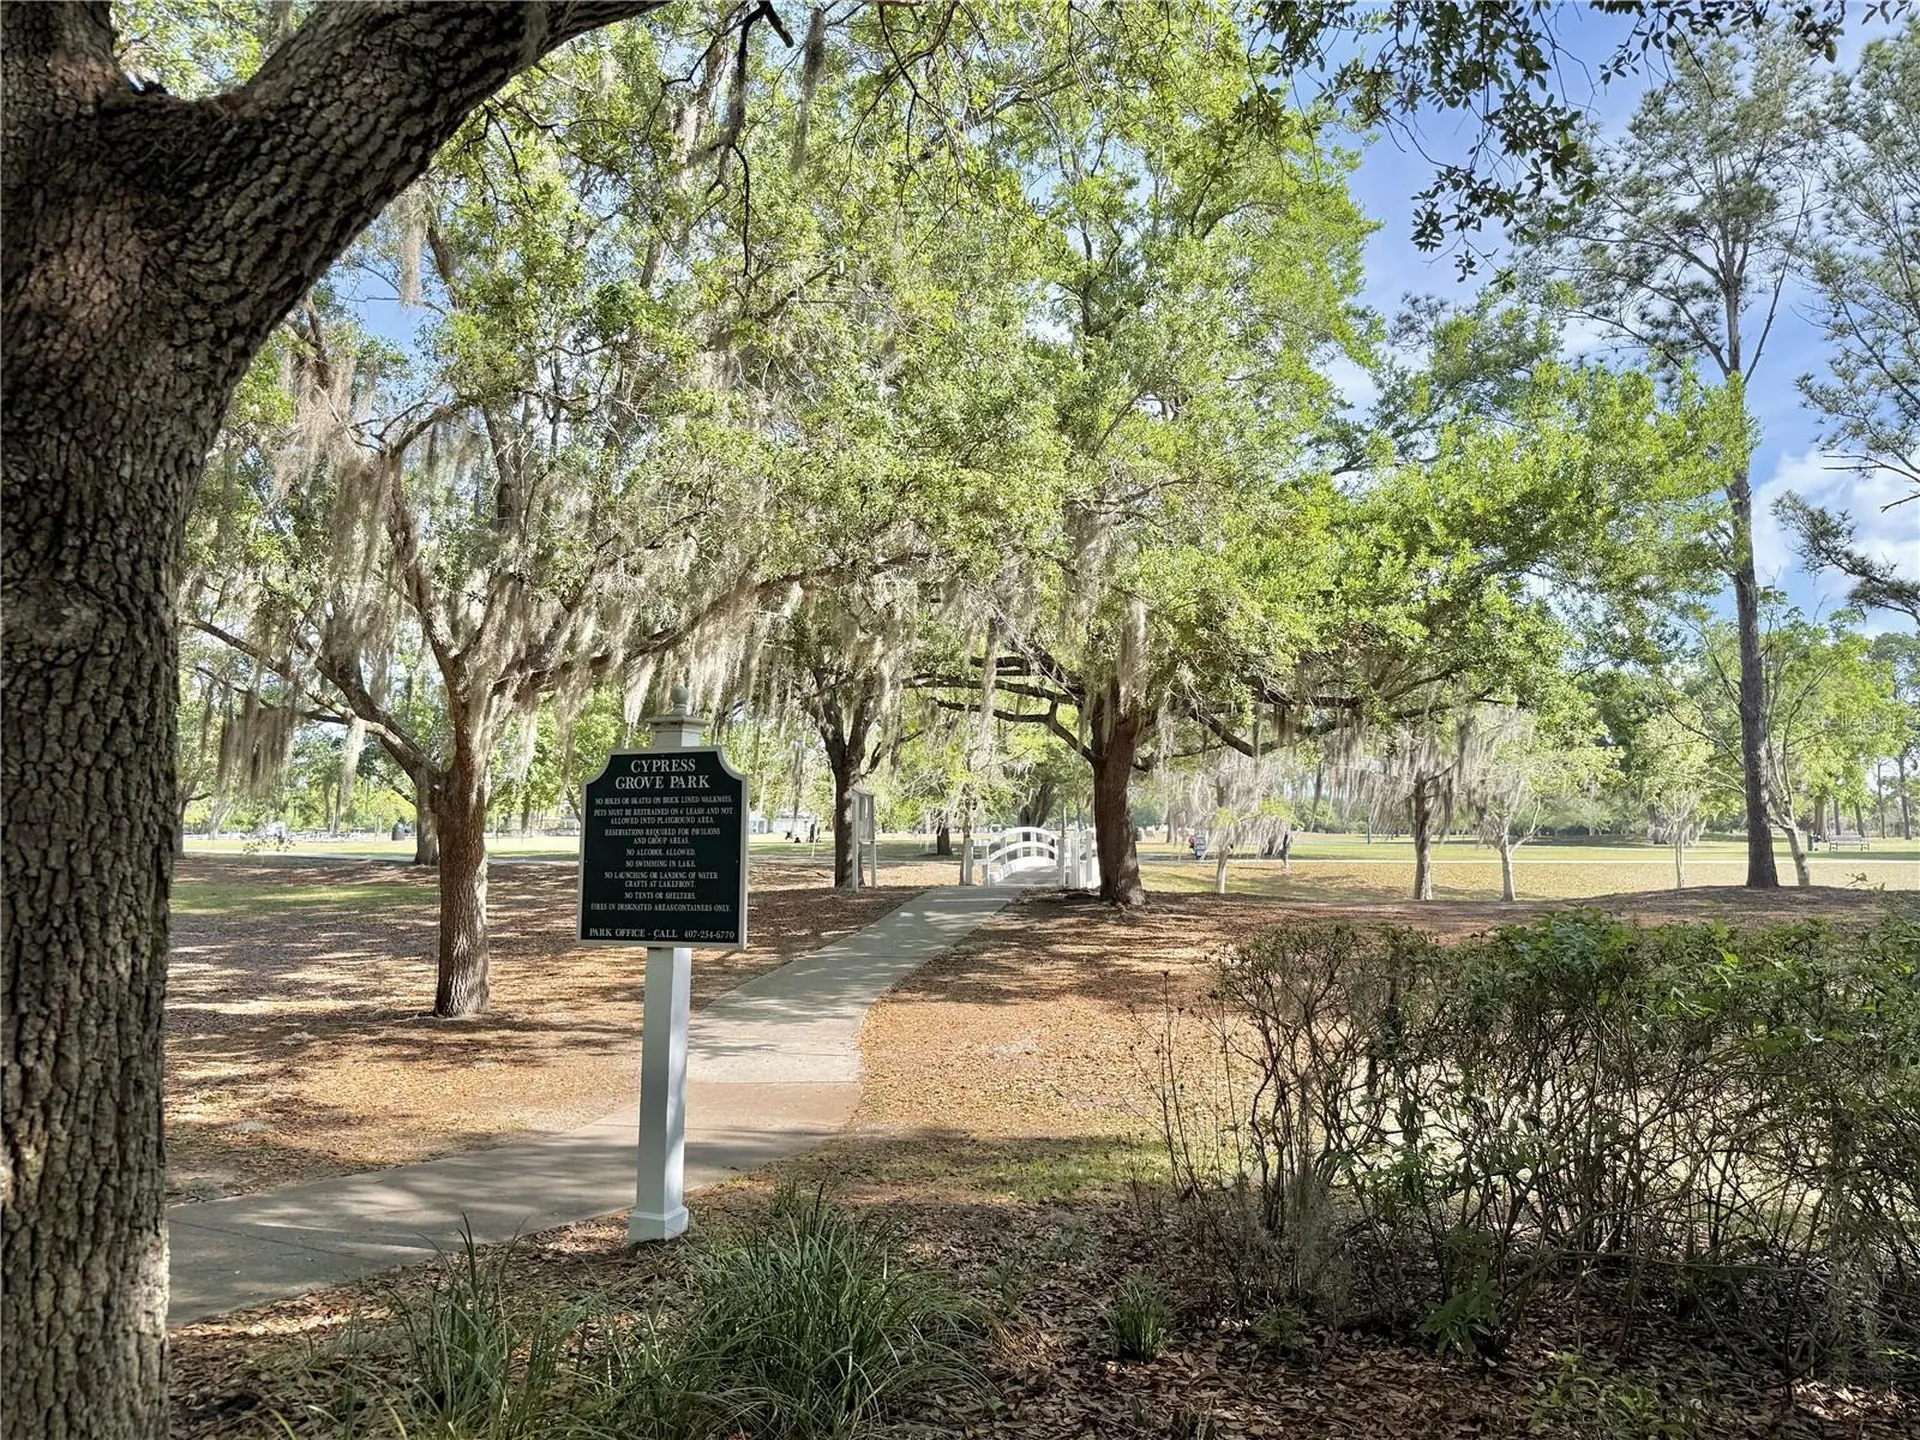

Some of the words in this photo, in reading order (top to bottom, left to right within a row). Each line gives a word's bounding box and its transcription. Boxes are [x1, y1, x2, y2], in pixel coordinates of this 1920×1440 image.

[630, 758, 696, 772] CYPRESS
[615, 776, 664, 790] GROVE
[669, 775, 710, 788] PARK
[645, 828, 676, 838] REQUIRED
[618, 903, 652, 911] DESIGNATED
[590, 928, 612, 936] PARK
[615, 928, 646, 938] OFFICE
[654, 930, 678, 938] CALL
